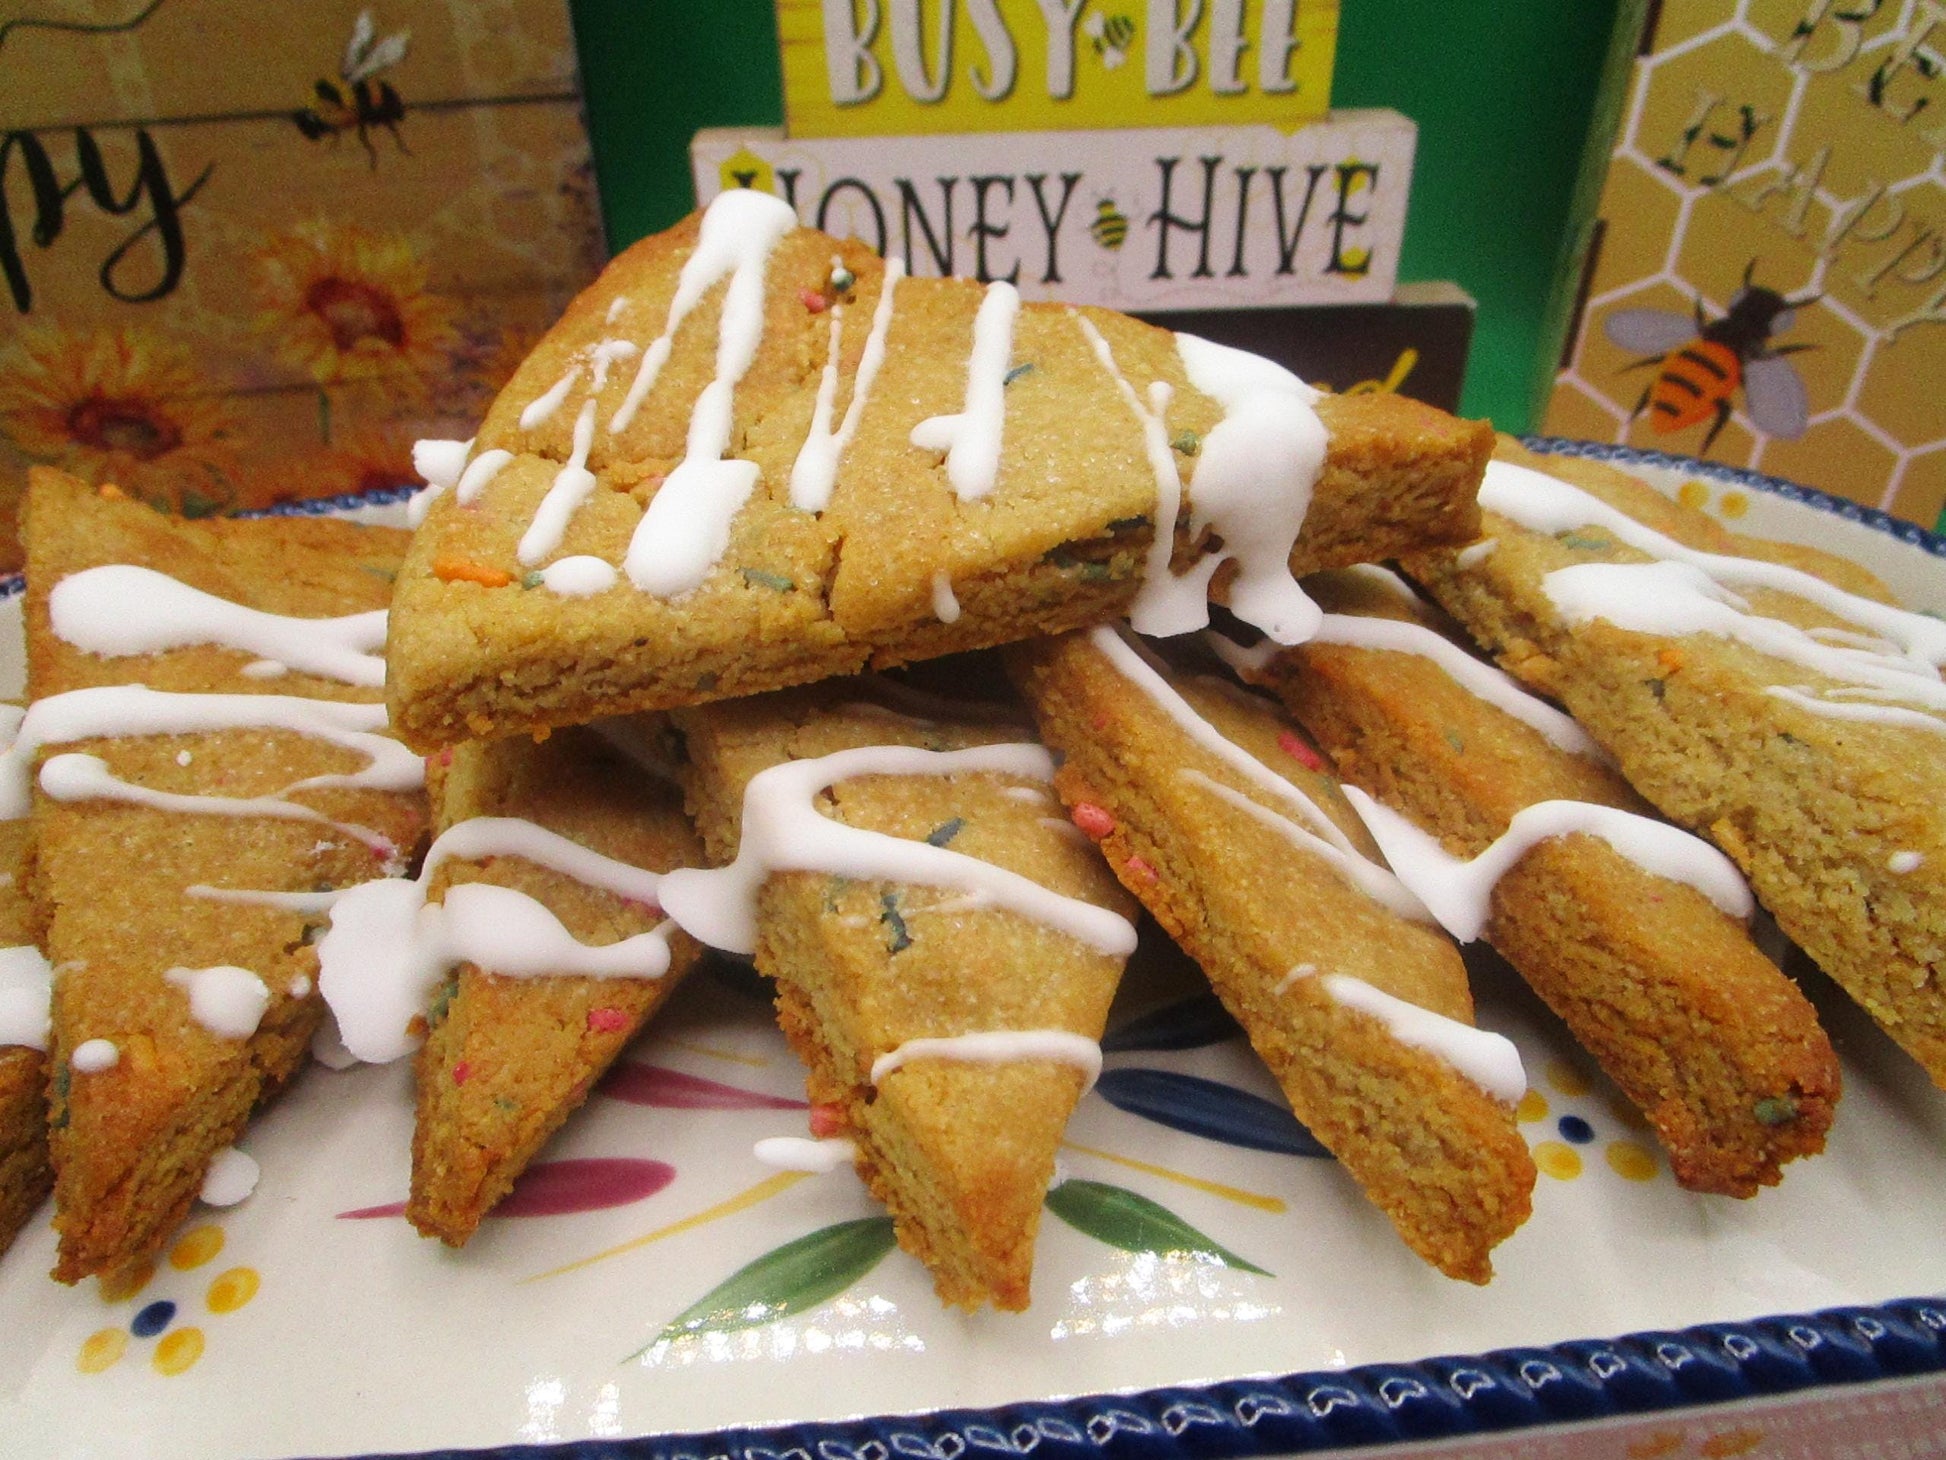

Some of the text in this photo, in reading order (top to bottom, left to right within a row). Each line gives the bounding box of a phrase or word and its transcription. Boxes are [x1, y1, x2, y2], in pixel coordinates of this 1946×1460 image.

[823, 0, 1301, 107] BUSY BEE
[1145, 156, 1380, 280] HIVE
